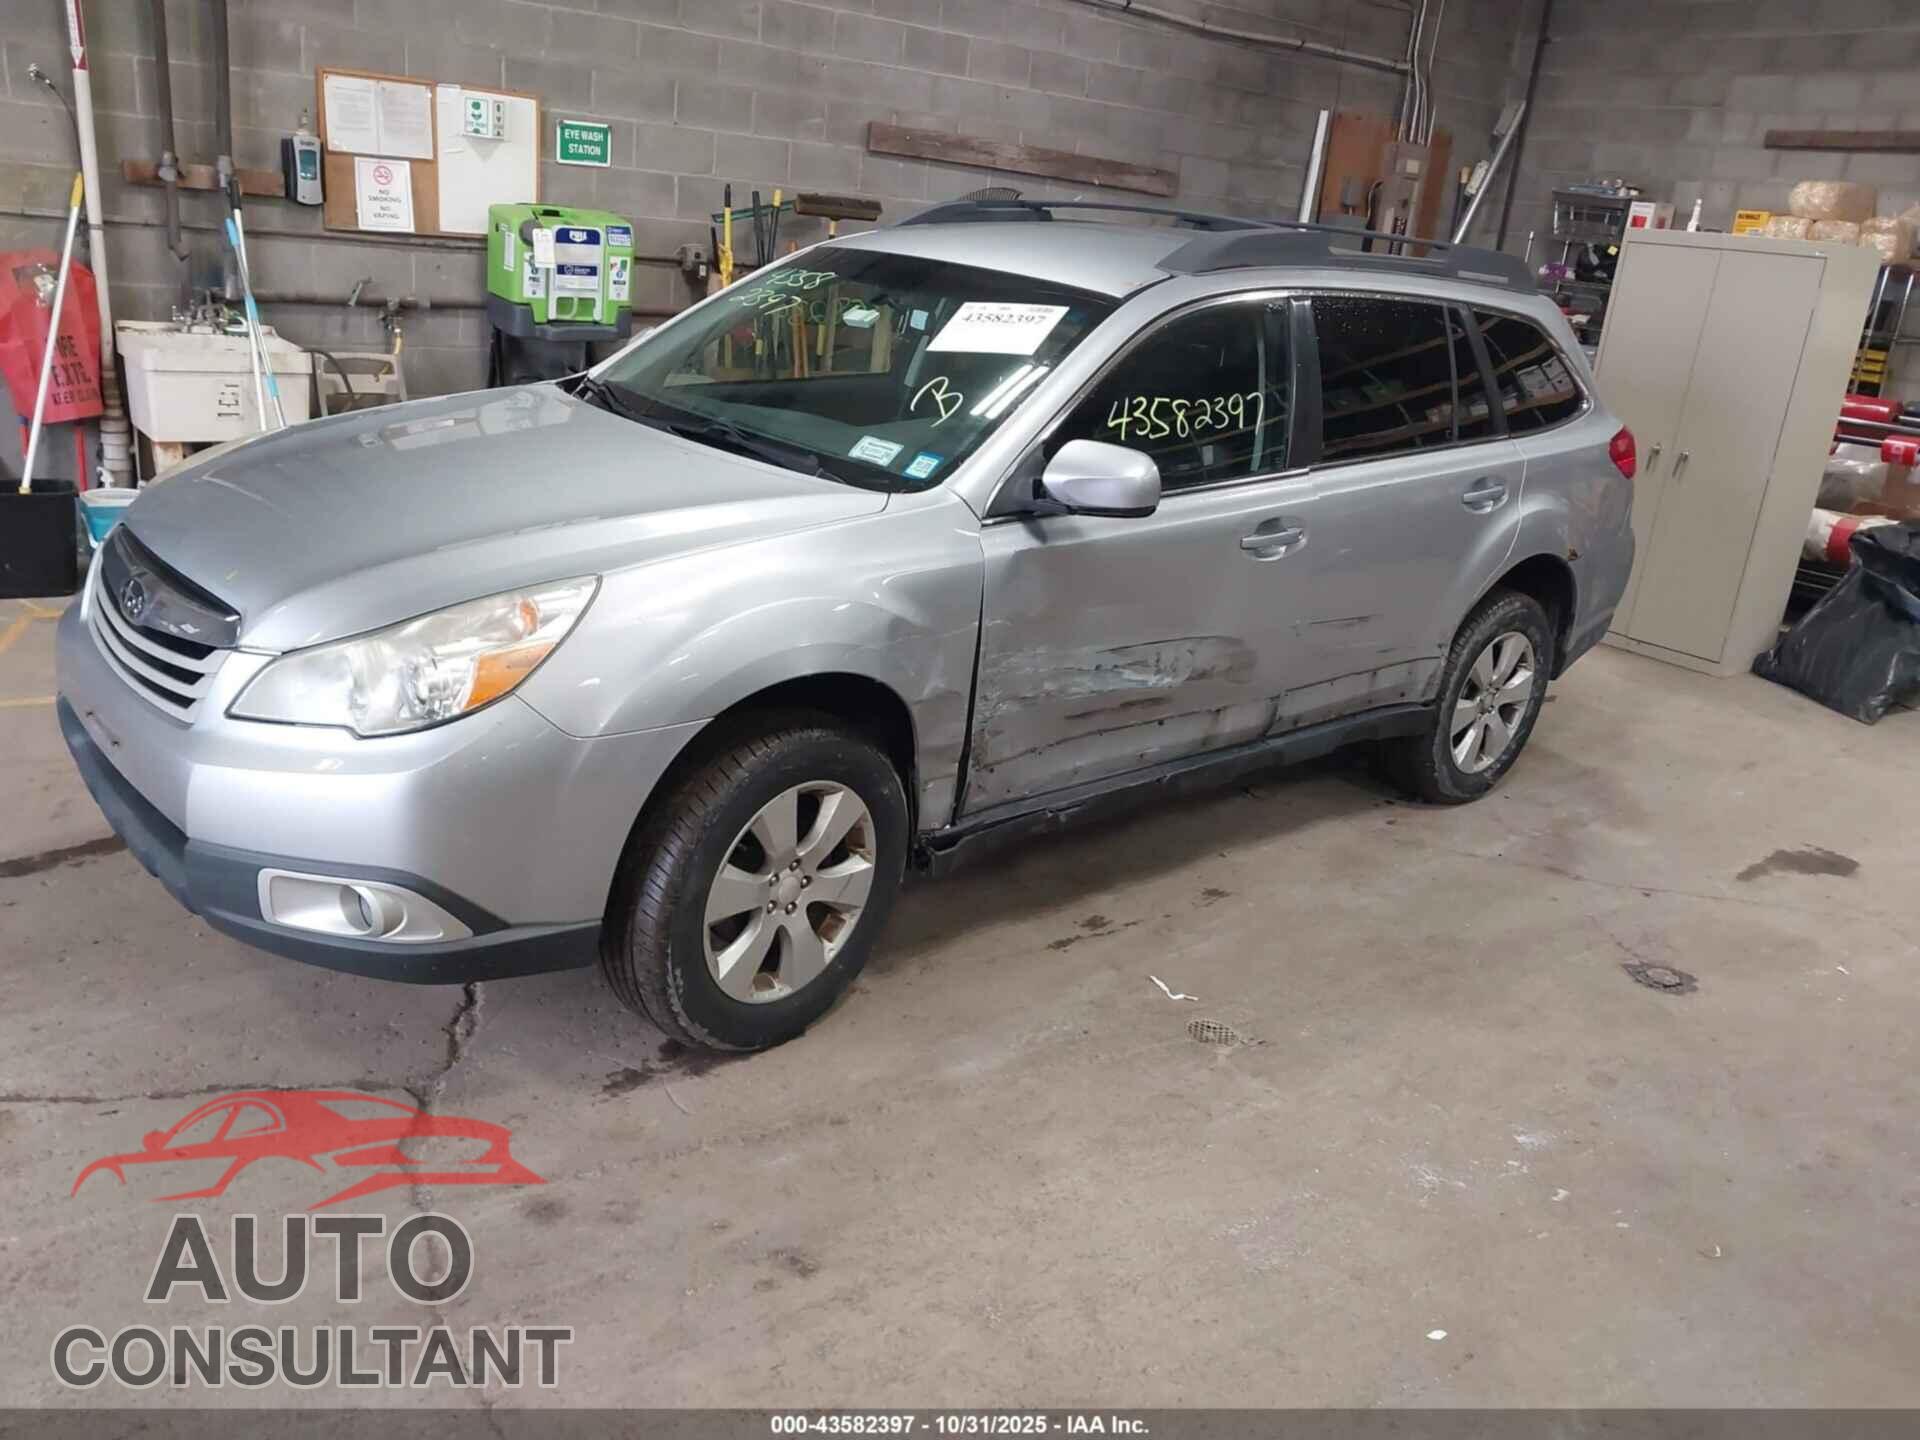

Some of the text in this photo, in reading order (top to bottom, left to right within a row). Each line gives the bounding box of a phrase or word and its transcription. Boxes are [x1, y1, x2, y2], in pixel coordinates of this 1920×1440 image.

[564, 128, 604, 142] EYE WASH
[568, 143, 601, 156] STATION
[367, 195, 402, 203] SMOKING
[961, 312, 1048, 325] 43582397
[910, 375, 964, 428] B
[1107, 392, 1264, 441] 43582397
